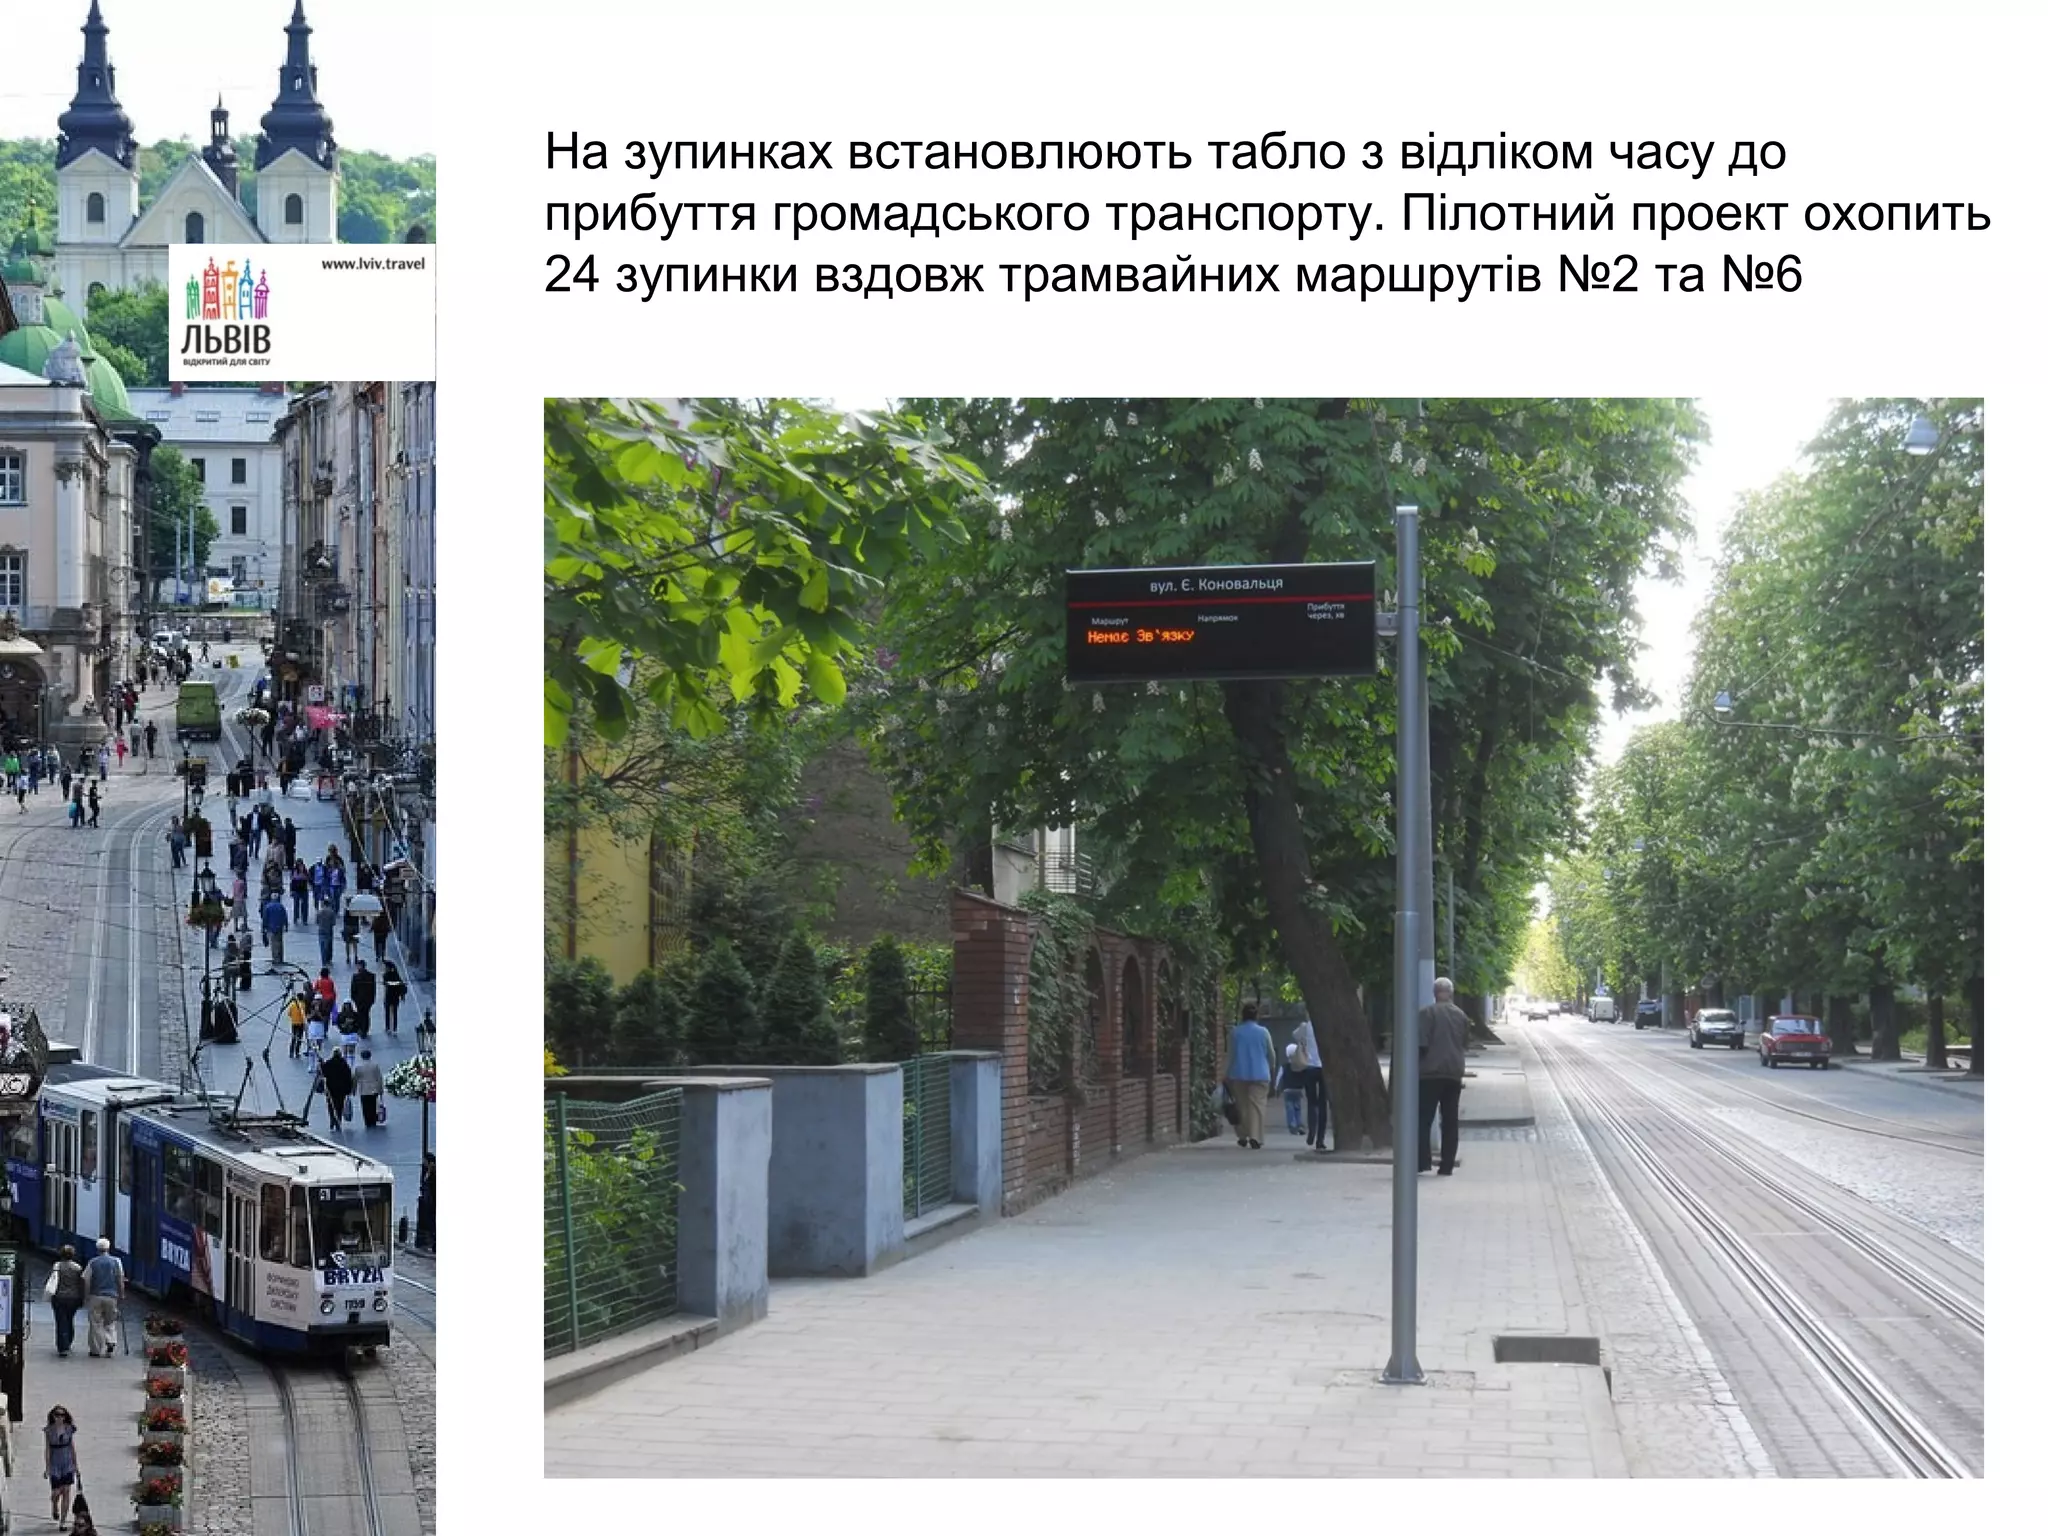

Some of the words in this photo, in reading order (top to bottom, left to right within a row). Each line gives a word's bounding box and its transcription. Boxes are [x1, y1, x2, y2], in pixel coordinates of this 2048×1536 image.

[1150, 582, 1178, 594] вул.
[1181, 579, 1195, 592] Є.
[1199, 577, 1284, 592] Коновальця
[1307, 602, 1346, 612] Прибуття
[1091, 617, 1129, 626] Маршрут
[1198, 614, 1239, 623] Напрямок
